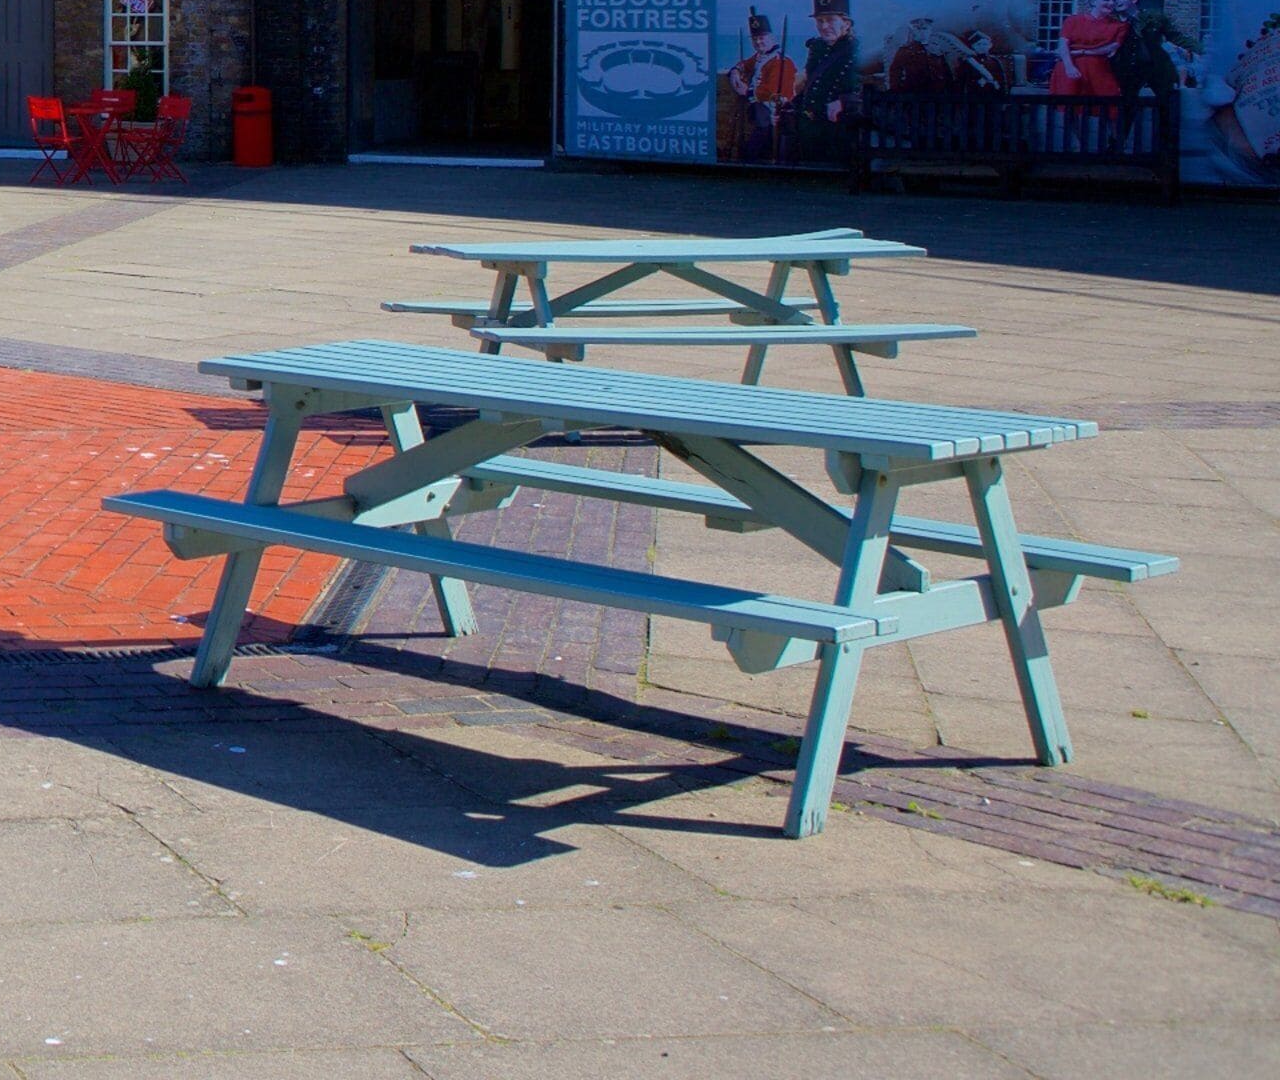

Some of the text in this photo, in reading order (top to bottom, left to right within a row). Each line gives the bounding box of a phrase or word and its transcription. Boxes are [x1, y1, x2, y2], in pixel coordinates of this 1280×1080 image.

[576, 8, 709, 29] FORTRESS
[576, 120, 708, 137] MILITARY MUSEUM
[576, 134, 709, 156] EASTBOURNE
